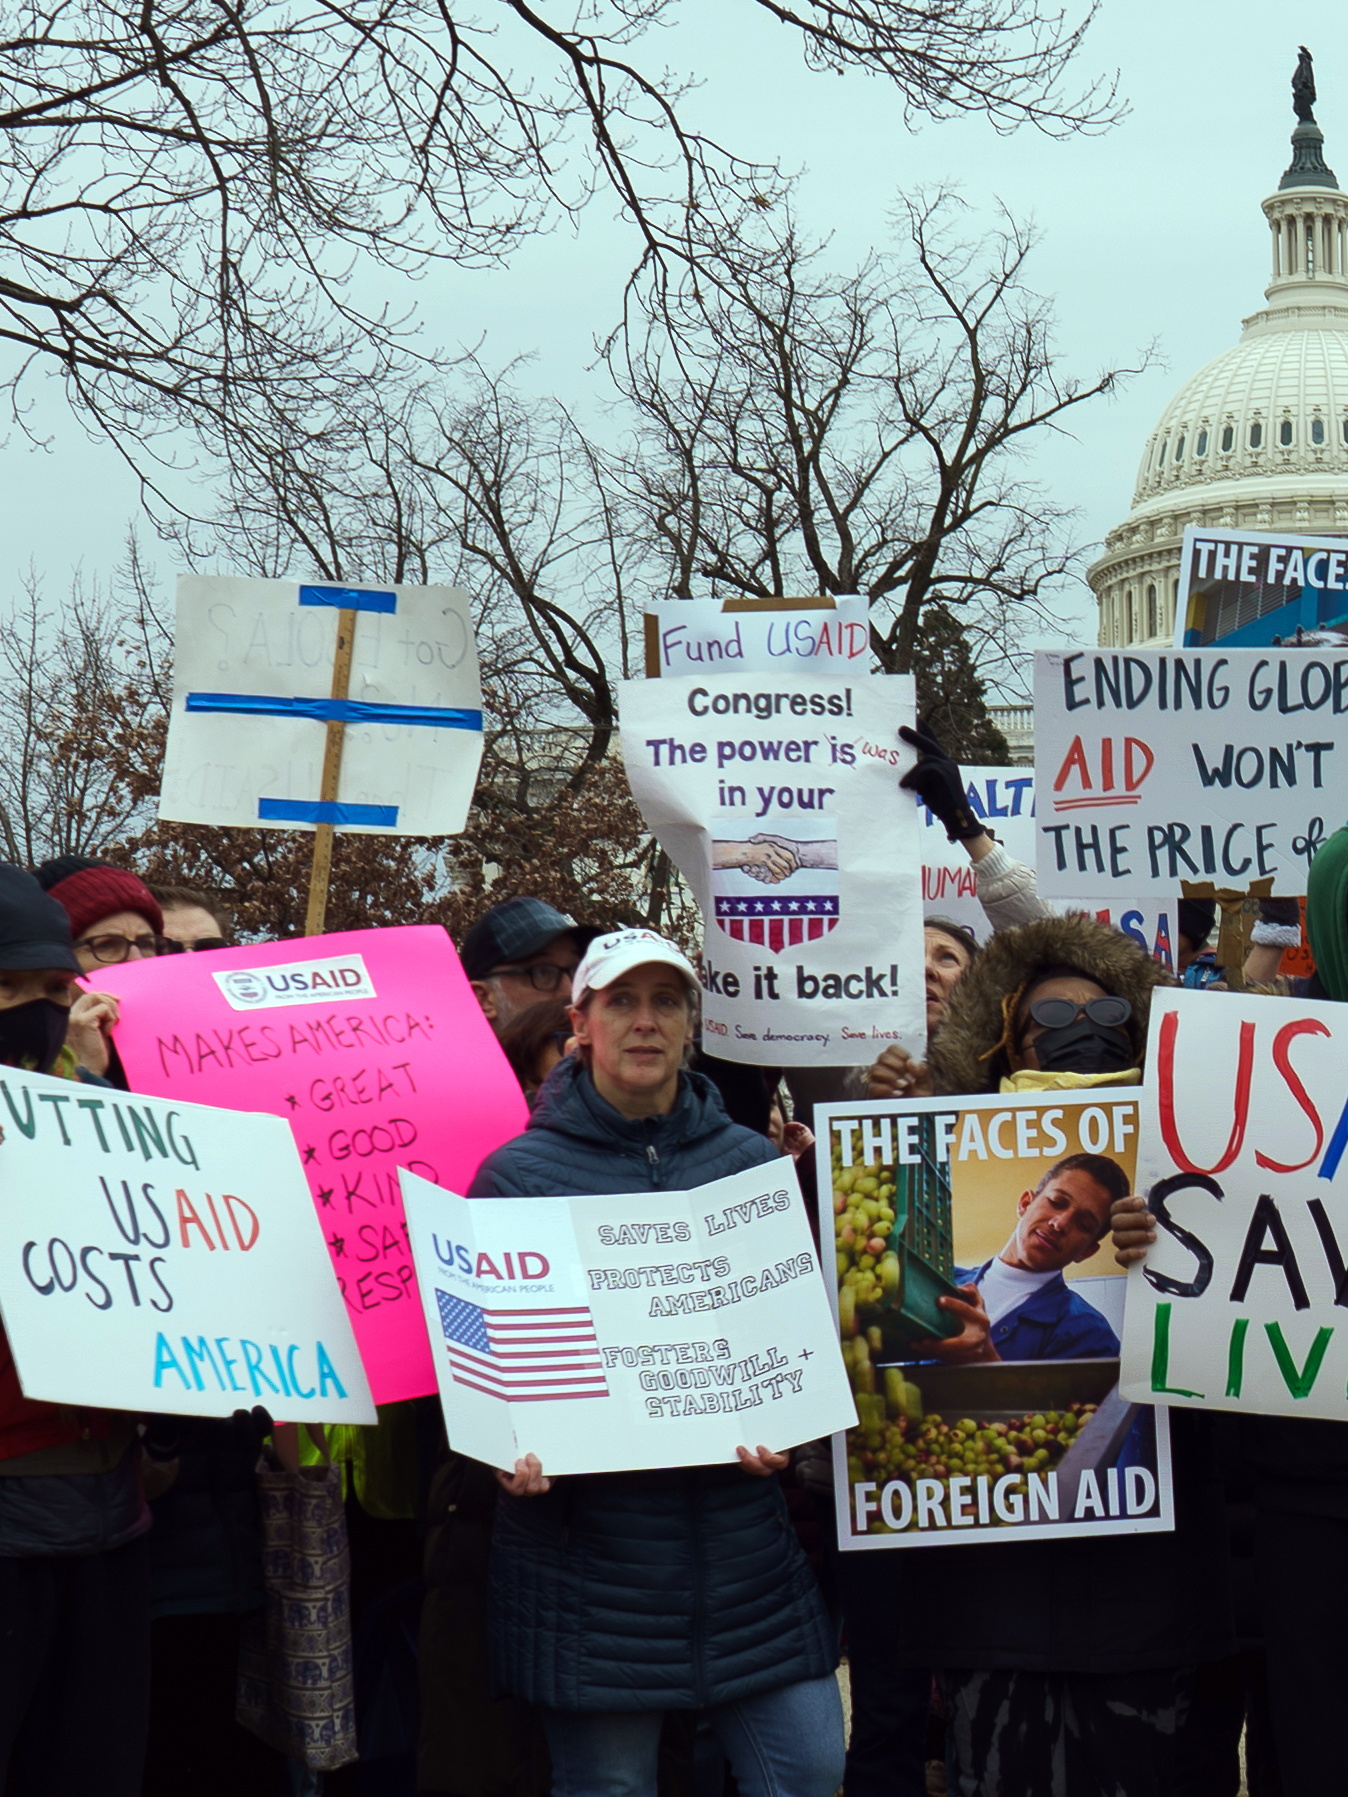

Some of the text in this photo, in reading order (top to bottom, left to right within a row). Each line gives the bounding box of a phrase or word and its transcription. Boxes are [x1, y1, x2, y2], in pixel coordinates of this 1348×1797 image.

[1195, 541, 1260, 582] THE
[662, 620, 868, 666] Fund USAID
[687, 687, 853, 719] Congress!
[1064, 652, 1229, 711] ENDING
[646, 735, 900, 768] The power is was
[1053, 735, 1154, 792] AID
[1192, 741, 1334, 788] WON'T
[719, 779, 835, 818] in your
[1042, 822, 1133, 878] THE
[1147, 822, 1278, 878] PRICE
[1291, 816, 1328, 869] of
[265, 968, 361, 992] USAID
[701, 960, 899, 1000] ake it back!
[156, 1013, 435, 1078] MAKES AMERICA:
[735, 1024, 757, 1041] Save
[841, 1026, 866, 1040] Save
[872, 1025, 902, 1040] lives.
[310, 1063, 418, 1112] GREAT
[0, 1080, 200, 1171] UTTING
[328, 1118, 418, 1161] GOOD
[832, 1105, 1134, 1167] THE FACES OF
[100, 1175, 260, 1251] USAID
[598, 1189, 791, 1246] SAVES LIVES
[23, 1238, 174, 1312] COSTS
[432, 1233, 550, 1280] USAID
[588, 1255, 730, 1290] PROTECTS
[337, 1265, 413, 1314] RESP
[471, 1282, 518, 1294] AMERICAN
[519, 1284, 555, 1293] PEOPLE
[649, 1252, 814, 1317] AMERICANS
[153, 1332, 348, 1399] AMERICA
[602, 1338, 731, 1368] FOSTERS
[639, 1346, 788, 1391] GOODWILL
[645, 1369, 804, 1418] STABILITY
[854, 1466, 1156, 1531] FOREIGN AID
